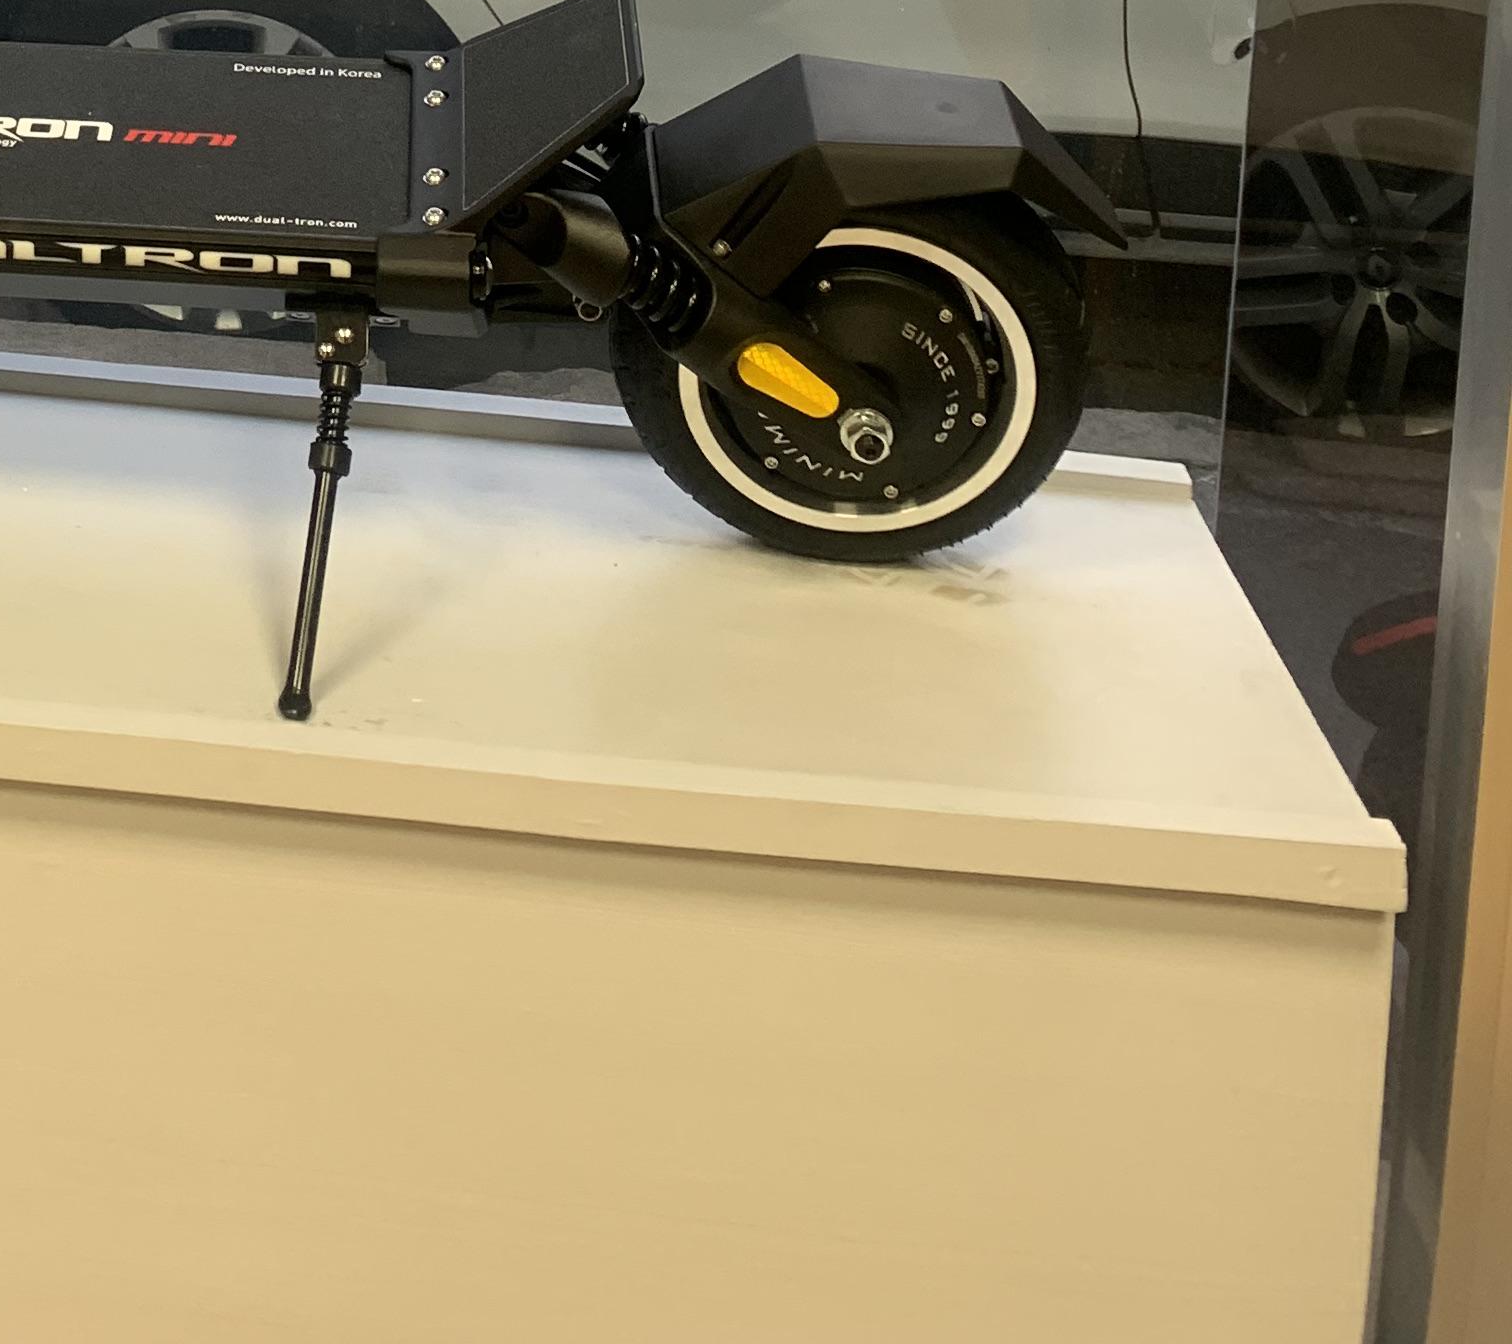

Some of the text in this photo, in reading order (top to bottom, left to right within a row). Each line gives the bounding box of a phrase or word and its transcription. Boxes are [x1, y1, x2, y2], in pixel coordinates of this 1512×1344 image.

[233, 62, 382, 80] Developed in Korea
[123, 127, 237, 147] mini
[214, 212, 358, 229] www.dual-tron.com
[901, 322, 960, 443] SINCE 1999
[757, 410, 864, 482] MINIM
